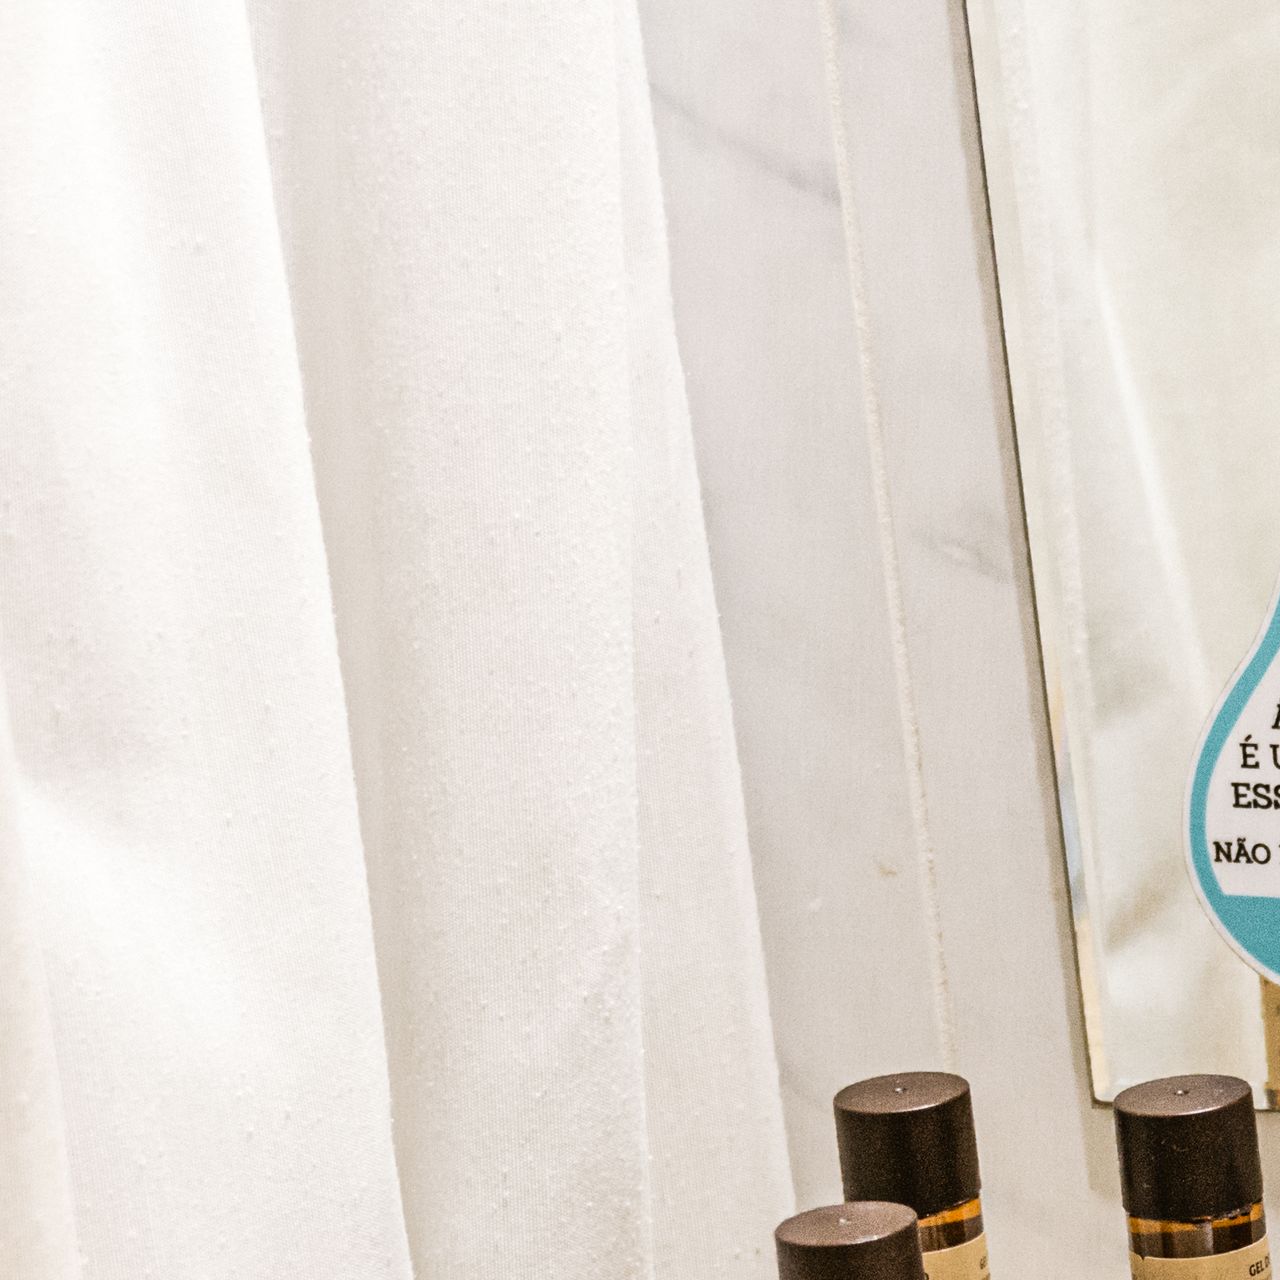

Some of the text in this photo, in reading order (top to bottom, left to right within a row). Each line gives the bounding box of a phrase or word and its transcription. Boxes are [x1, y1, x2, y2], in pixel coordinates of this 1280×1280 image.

[1239, 734, 1260, 770] É
[1212, 837, 1272, 865] NÃO
[1249, 1259, 1264, 1277] GEL
